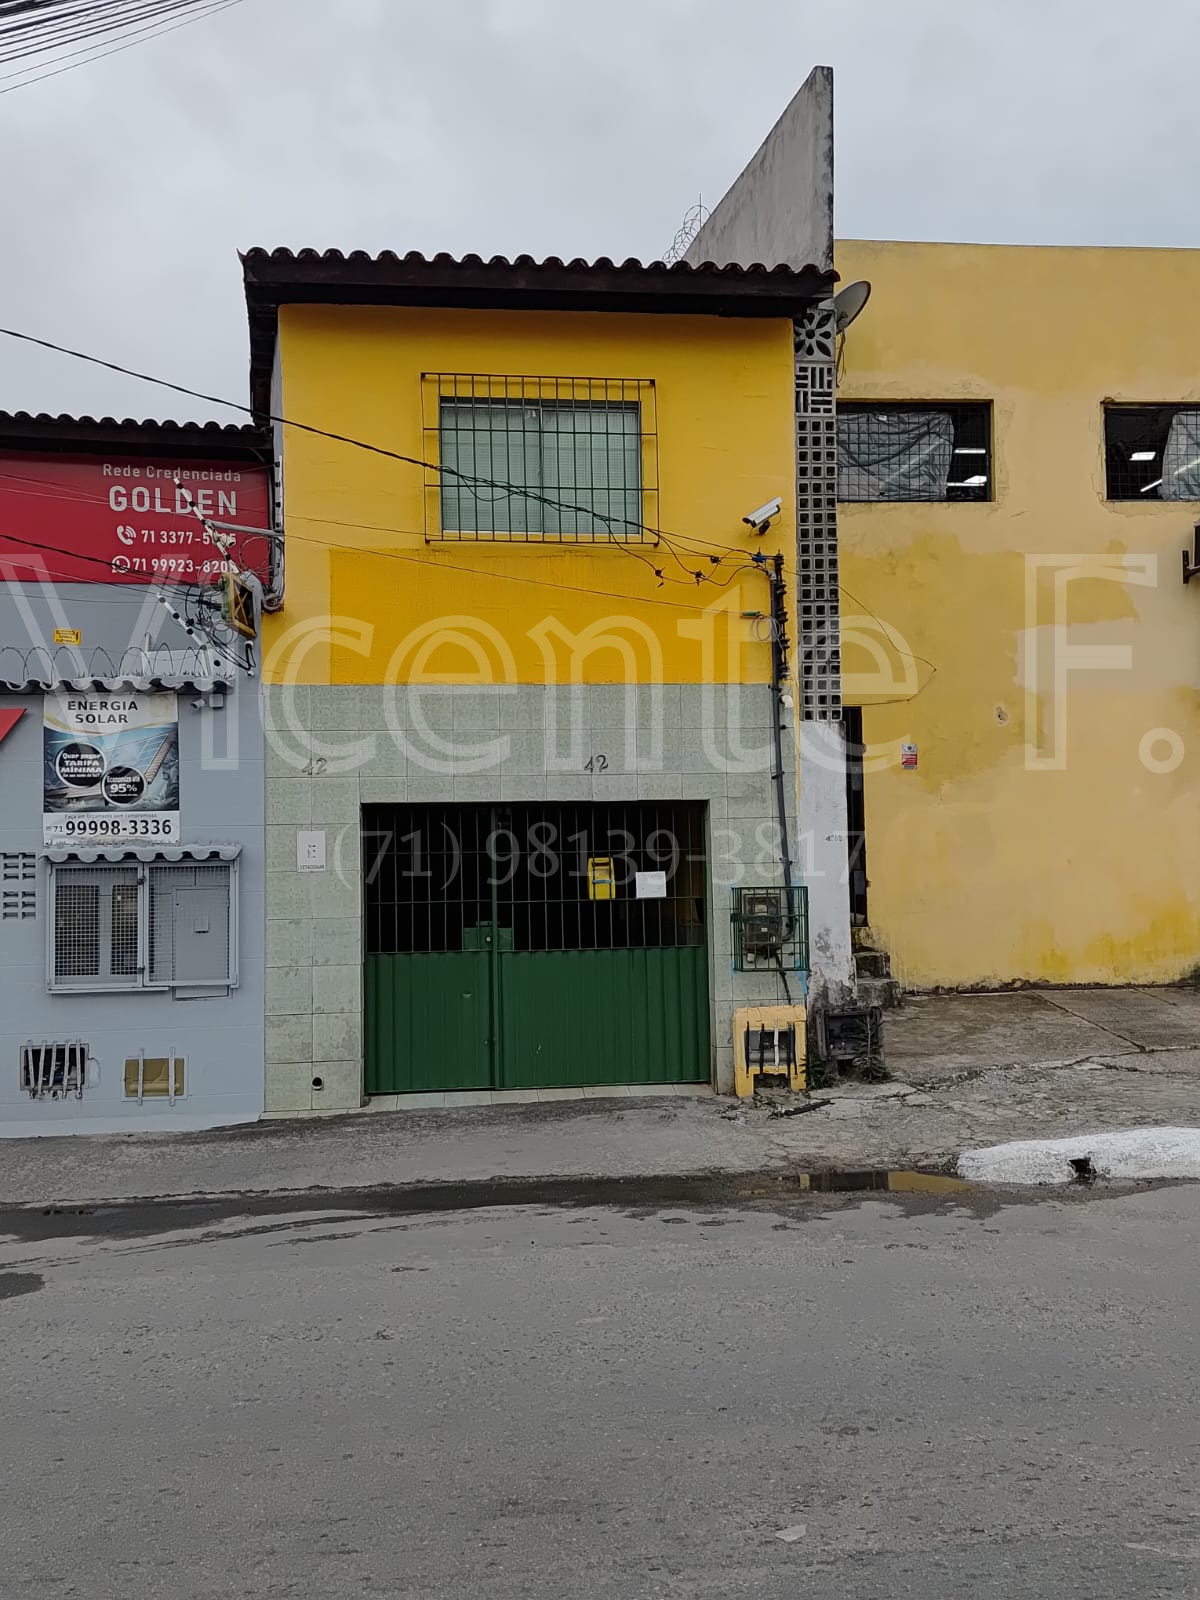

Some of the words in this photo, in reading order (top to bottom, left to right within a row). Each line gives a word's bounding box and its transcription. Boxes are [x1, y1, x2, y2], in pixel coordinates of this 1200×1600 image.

[103, 463, 141, 478] Rede
[146, 465, 241, 482] Credenciada
[109, 485, 237, 516] GOLDEN
[141, 530, 155, 543] 71
[133, 558, 147, 571] 71
[67, 700, 139, 711] ENERGIA
[75, 713, 128, 724] SOLAR
[584, 754, 609, 773] 42
[110, 783, 138, 793] 95%
[53, 825, 63, 833] 71
[66, 819, 172, 836] 99998-3336
